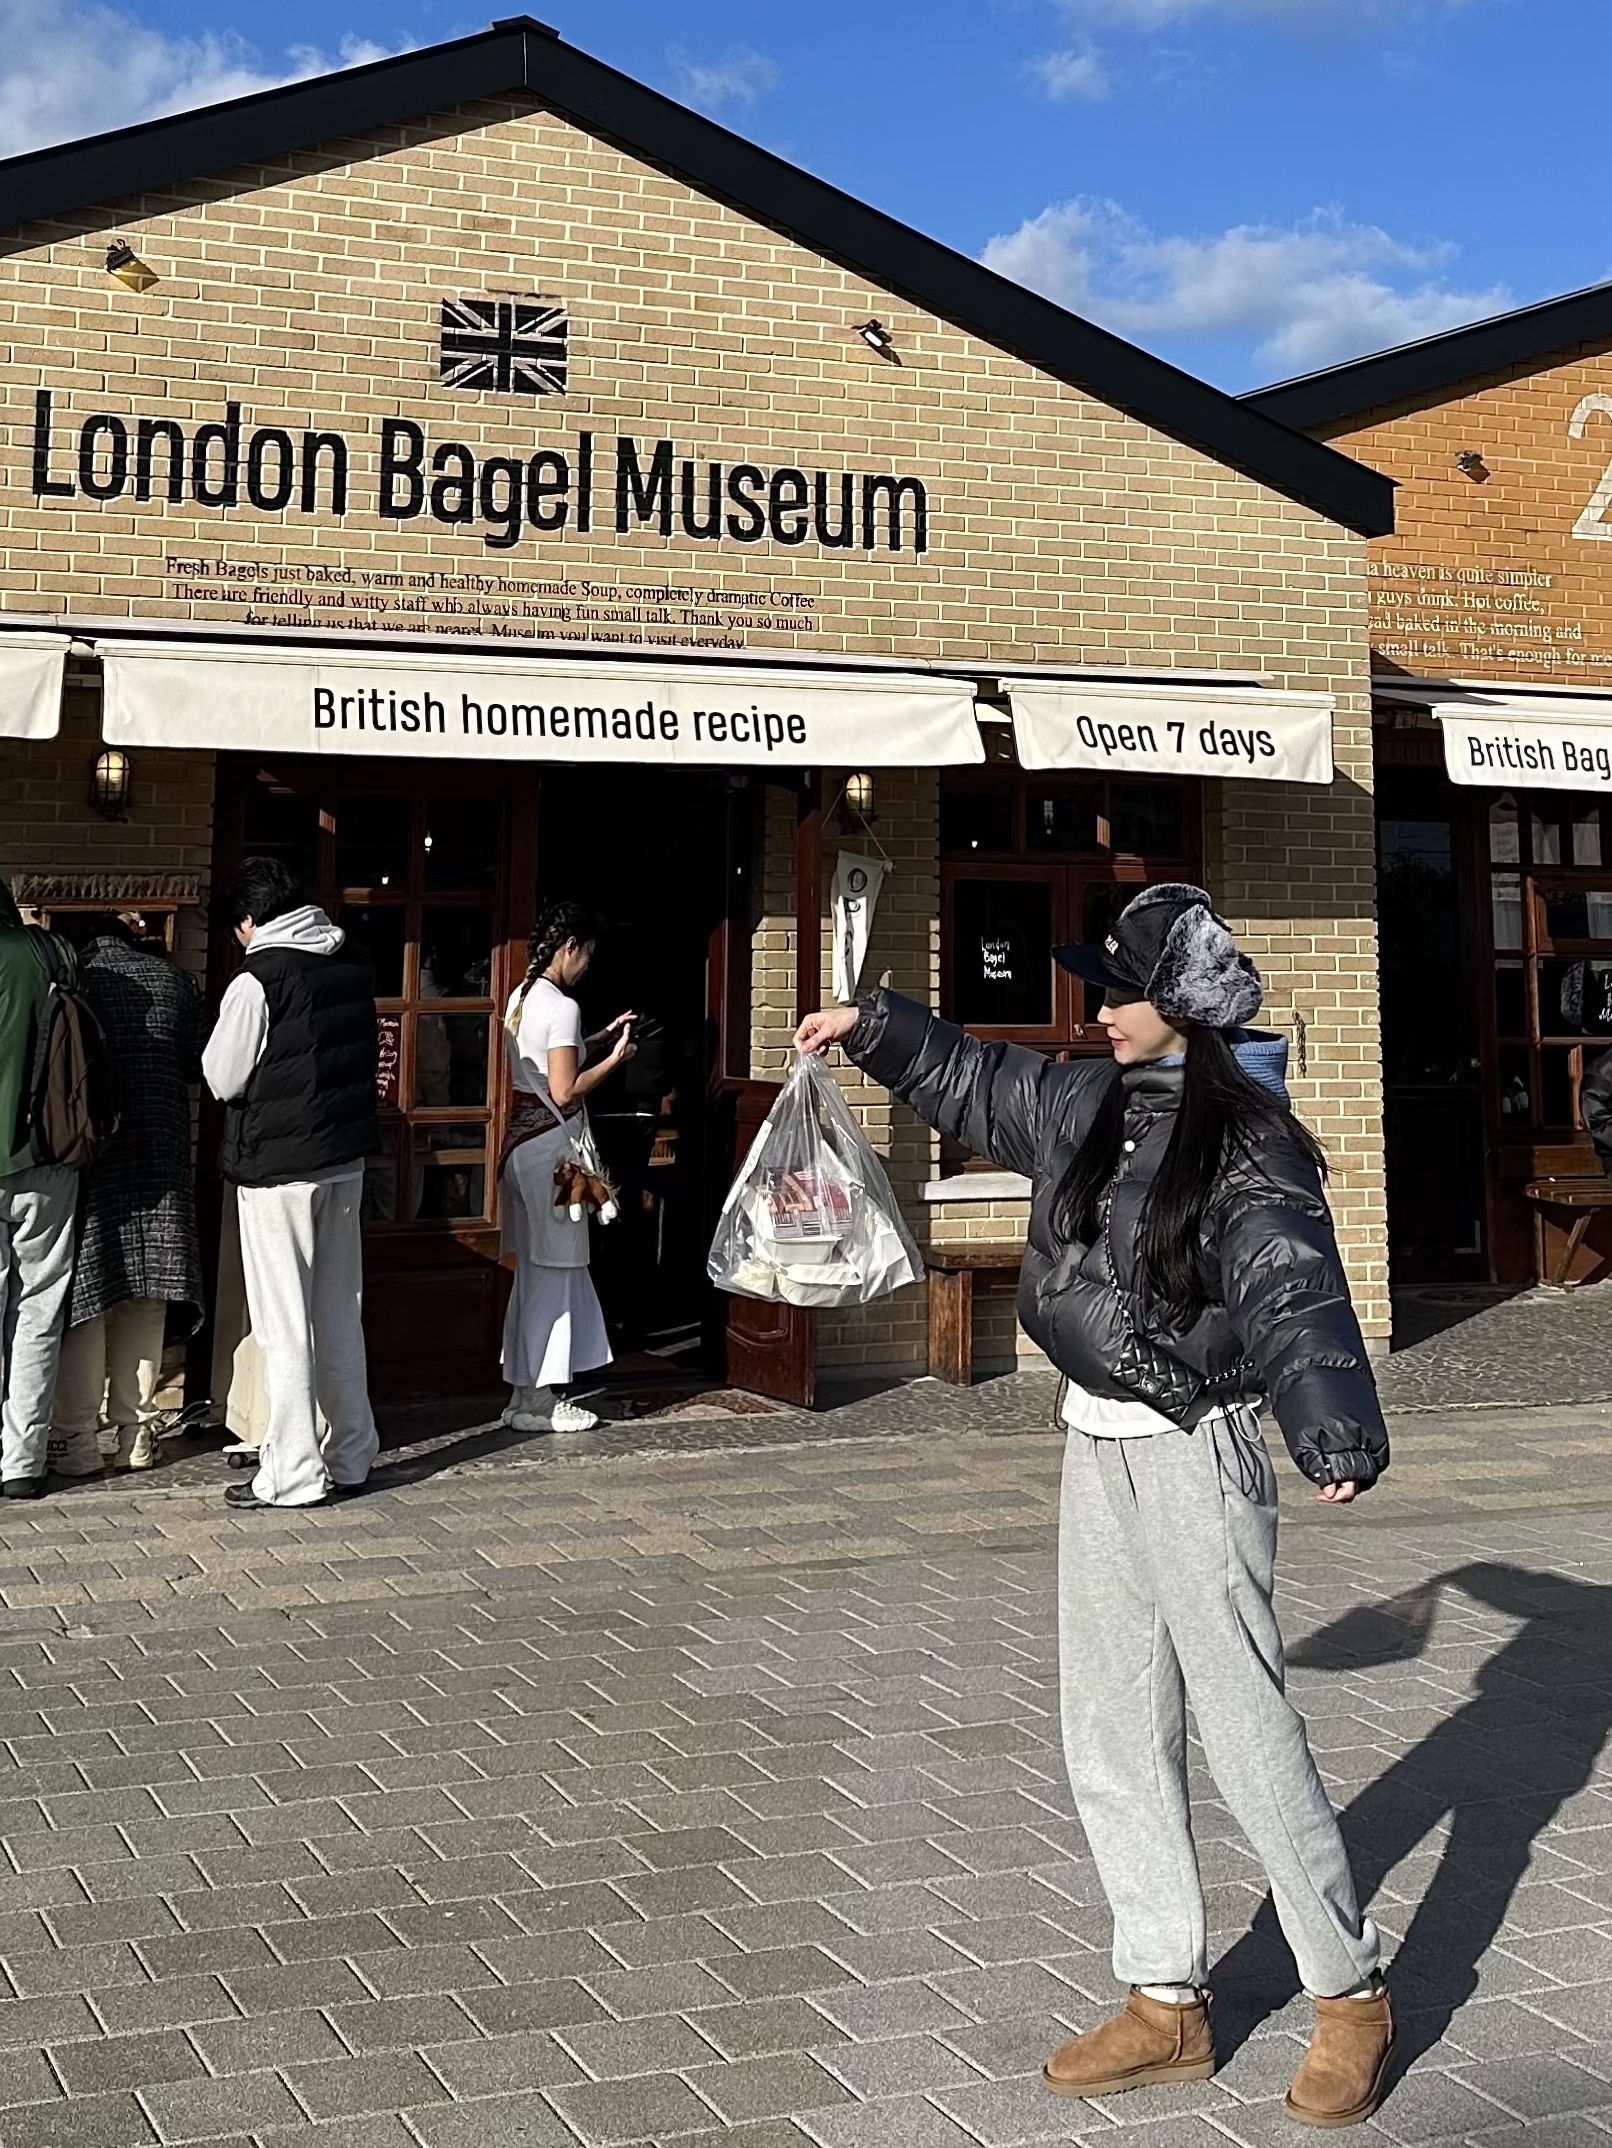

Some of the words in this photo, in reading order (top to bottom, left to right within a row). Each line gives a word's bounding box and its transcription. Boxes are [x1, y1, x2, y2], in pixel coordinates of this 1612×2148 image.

[32, 389, 348, 516] London
[379, 417, 592, 546] Bagel
[615, 437, 928, 554] Museum
[166, 556, 210, 575] Fresh
[215, 560, 268, 581] Bagels
[272, 564, 302, 583] just
[306, 565, 356, 585] baked,
[362, 572, 404, 586] warm
[408, 573, 435, 588] and
[440, 574, 494, 595] healthy
[498, 577, 577, 595] homemade
[581, 581, 622, 600] Soup,
[626, 585, 703, 607] completely
[707, 588, 766, 605] dramatic
[770, 592, 815, 608] Coffee
[1383, 563, 1436, 580] heaven
[1438, 563, 1453, 581] is
[1457, 565, 1494, 588] quite
[1498, 567, 1552, 589] simpler
[172, 583, 218, 600] There
[222, 587, 247, 602] are
[252, 587, 313, 608] friendly
[318, 591, 345, 607] and
[350, 594, 389, 613] witty
[394, 596, 429, 611] staff
[431, 598, 463, 613] who
[467, 600, 517, 618] always
[522, 602, 572, 622] having
[576, 604, 599, 620] fun
[603, 606, 641, 622] small
[646, 608, 676, 624] talk.
[680, 609, 724, 626] Thank
[728, 614, 753, 630] you
[757, 616, 771, 630] so
[776, 616, 813, 630] much
[1376, 591, 1412, 608] guys
[1417, 588, 1459, 608] think.
[1463, 591, 1492, 609] Hot
[1495, 593, 1545, 614] coffee,
[245, 611, 268, 625] for
[349, 617, 377, 630] that
[382, 622, 403, 632] we
[492, 624, 555, 639] Museum
[560, 630, 586, 641] you
[591, 632, 624, 643] want
[629, 632, 643, 644] to
[648, 631, 677, 646] visit
[1396, 612, 1441, 632] baked
[1445, 615, 1459, 633] in
[1463, 617, 1486, 634] the
[1490, 618, 1552, 643] morning
[1555, 622, 1582, 640] and
[1378, 640, 1420, 657] small
[1459, 642, 1505, 661] That's
[1508, 647, 1561, 668] enough
[1565, 648, 1587, 665] for
[1590, 652, 1612, 667] me
[313, 687, 446, 733] British
[462, 693, 680, 741] homemade
[693, 705, 807, 751] recipe
[1076, 715, 1158, 757] Open
[1166, 721, 1185, 753] 7
[1199, 720, 1275, 764] days
[1467, 736, 1555, 770] British
[1562, 741, 1612, 781] Bag
